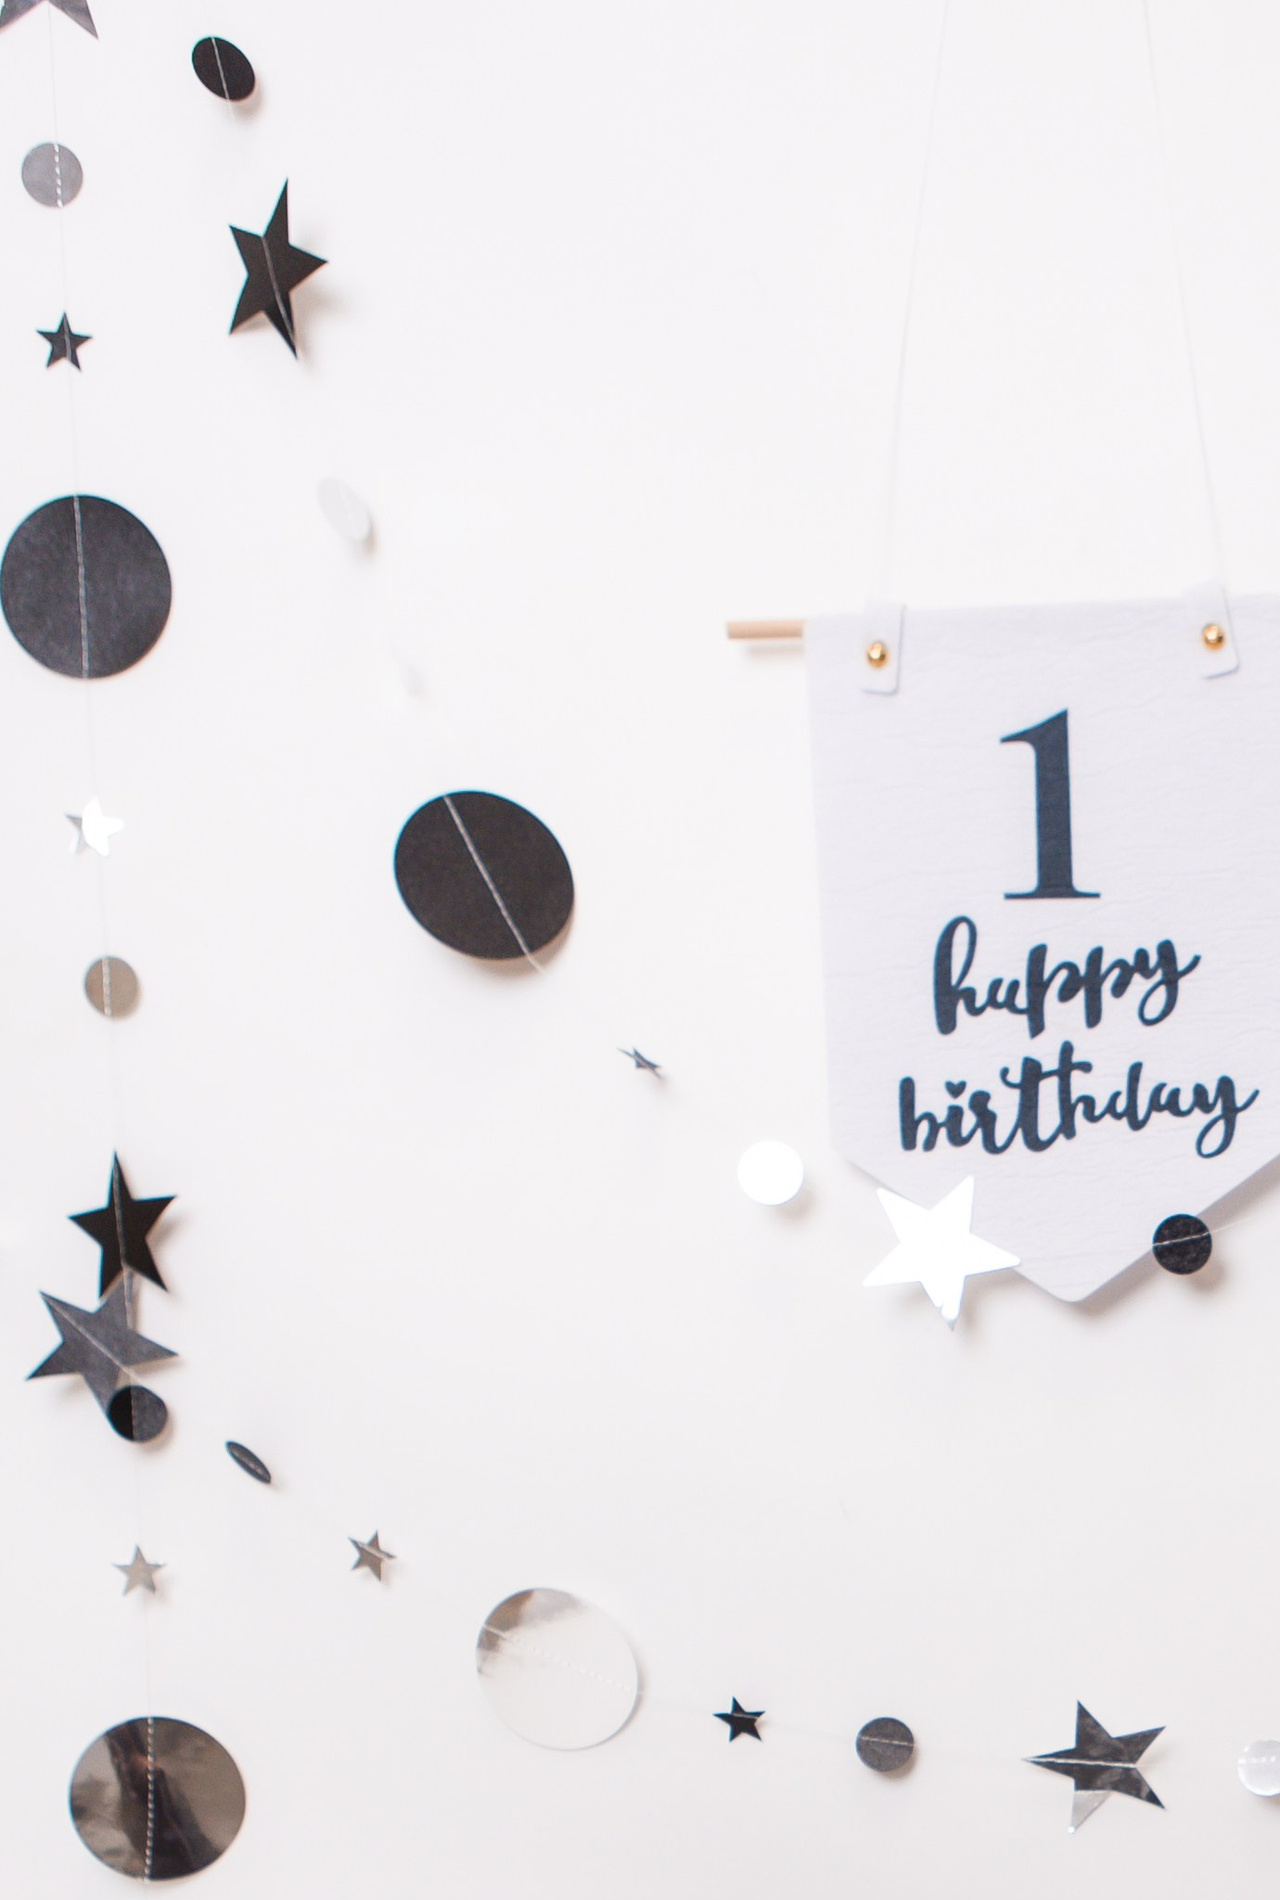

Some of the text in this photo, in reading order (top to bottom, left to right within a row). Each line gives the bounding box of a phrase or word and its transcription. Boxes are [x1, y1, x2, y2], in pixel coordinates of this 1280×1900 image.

[999, 707, 1101, 900] 1
[933, 915, 1201, 1039] happy
[898, 1040, 1260, 1159] birthday
